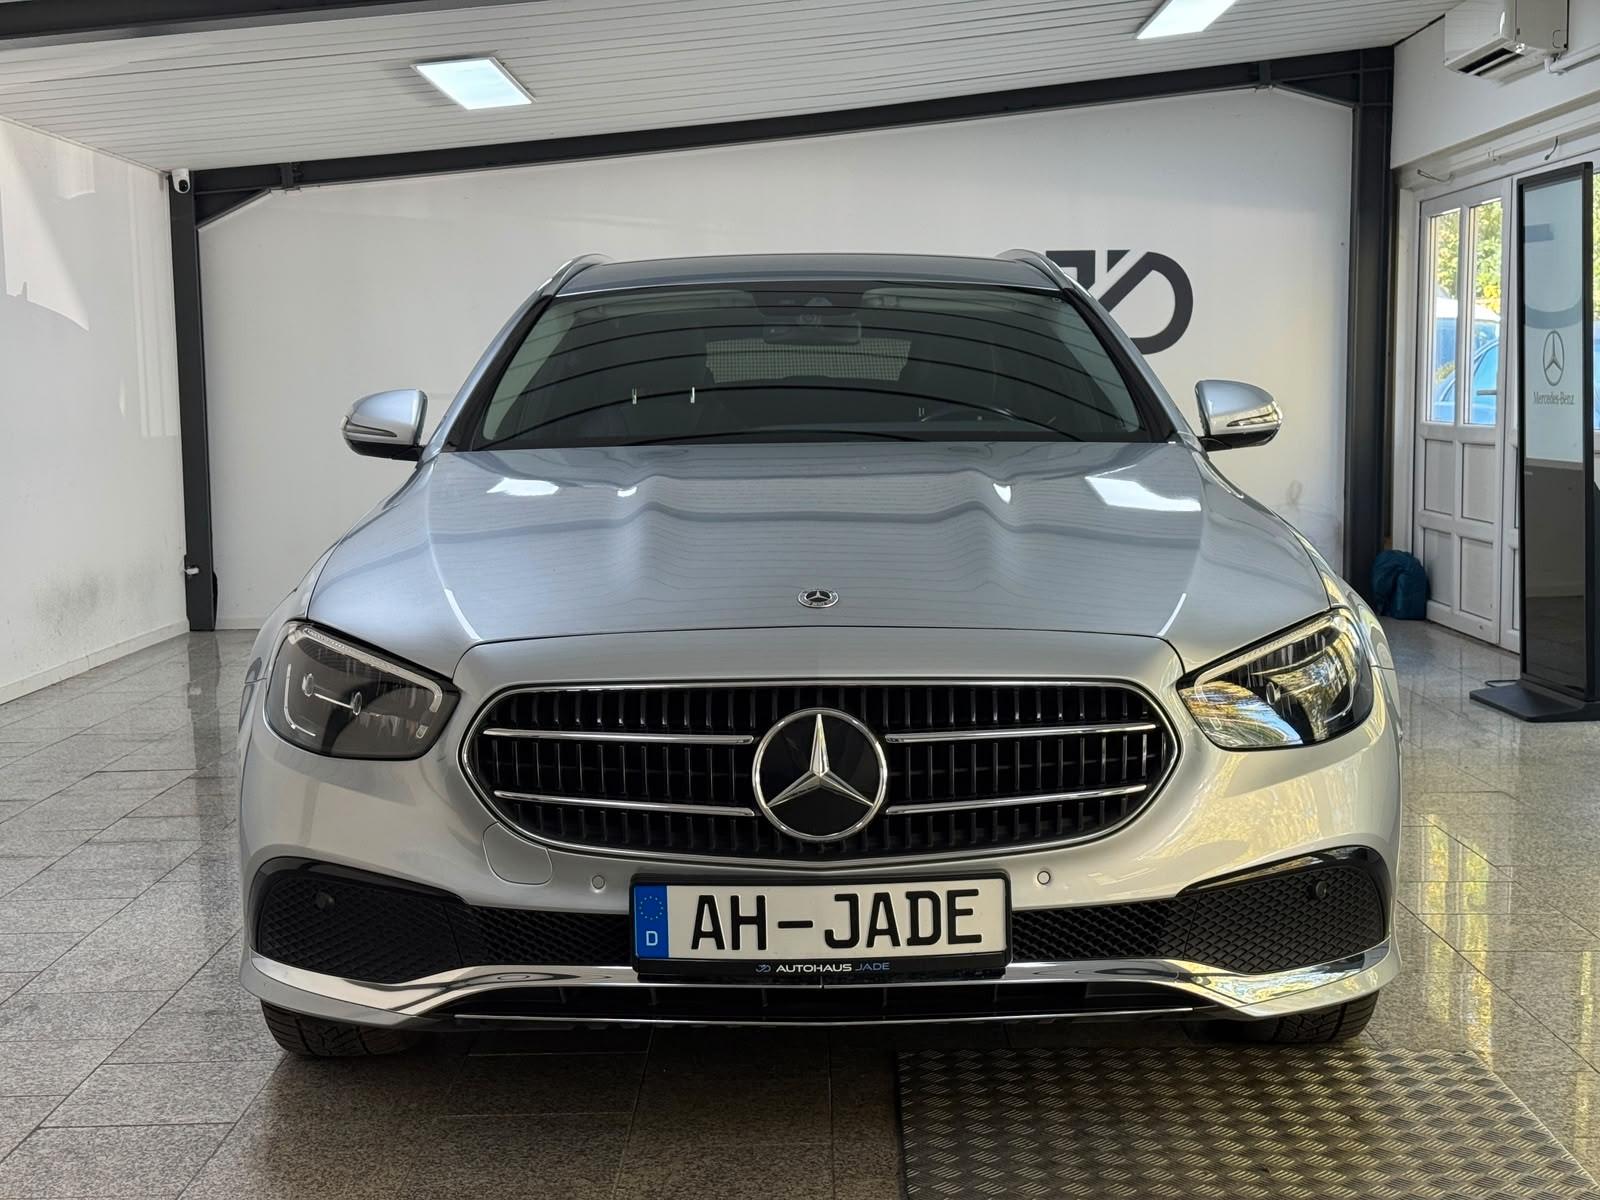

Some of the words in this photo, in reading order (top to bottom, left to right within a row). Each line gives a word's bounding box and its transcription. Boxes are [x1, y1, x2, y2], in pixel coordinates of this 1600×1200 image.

[645, 930, 658, 946] D
[776, 963, 852, 973] AUTOHAUS
[855, 962, 891, 972] JADE
